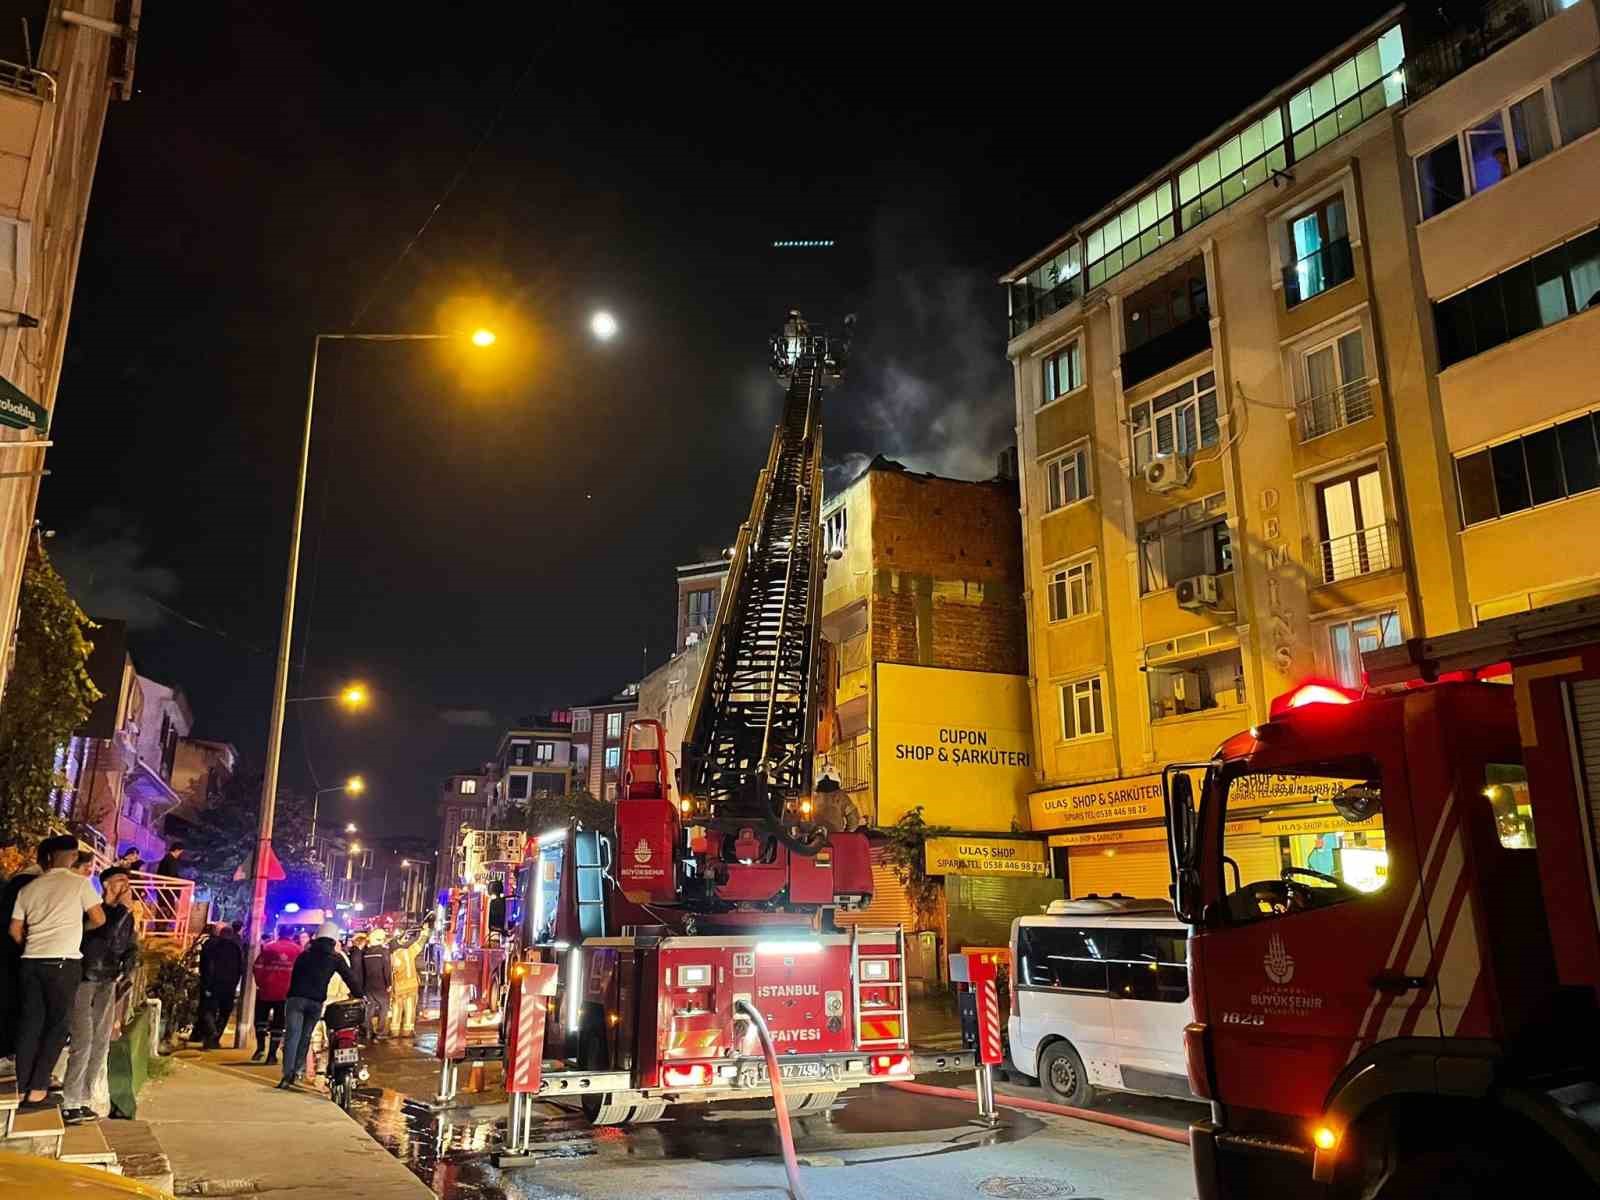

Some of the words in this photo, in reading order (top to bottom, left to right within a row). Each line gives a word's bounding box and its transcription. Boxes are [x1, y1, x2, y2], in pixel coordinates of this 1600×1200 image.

[939, 728, 987, 746] CUPON
[896, 744, 935, 761] SHOP
[938, 747, 950, 762] &
[1072, 795, 1098, 809] SHOP
[1099, 792, 1106, 806] &
[991, 847, 1016, 858] SHOP
[735, 955, 752, 966] 112
